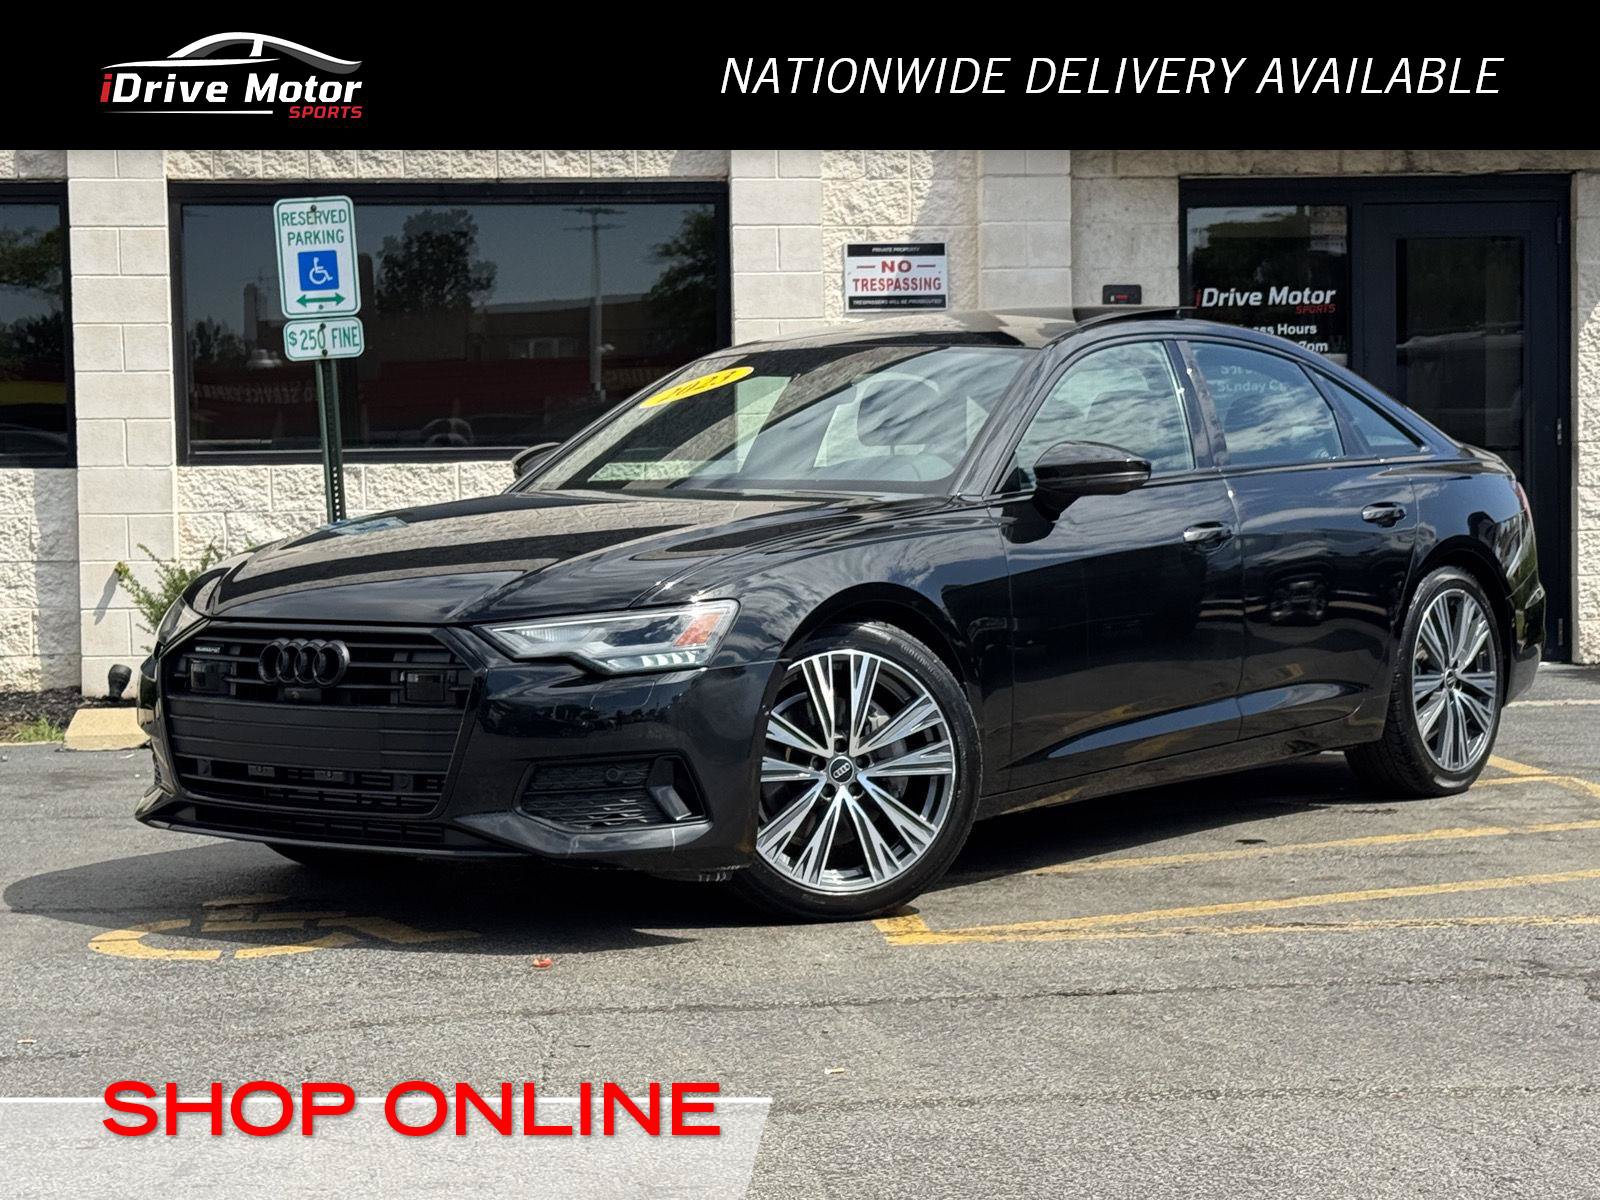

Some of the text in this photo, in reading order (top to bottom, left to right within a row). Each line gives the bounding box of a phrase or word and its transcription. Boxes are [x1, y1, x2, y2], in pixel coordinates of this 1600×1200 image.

[282, 209, 347, 226] RESERVED
[287, 229, 345, 246] PARKING
[881, 260, 912, 273] NO
[852, 277, 942, 292] TRESPASSING
[1194, 286, 1337, 308] iDrive Motor
[1295, 303, 1337, 315] SPORTS
[1277, 323, 1318, 335] Hours
[288, 326, 360, 350] $250 FINE
